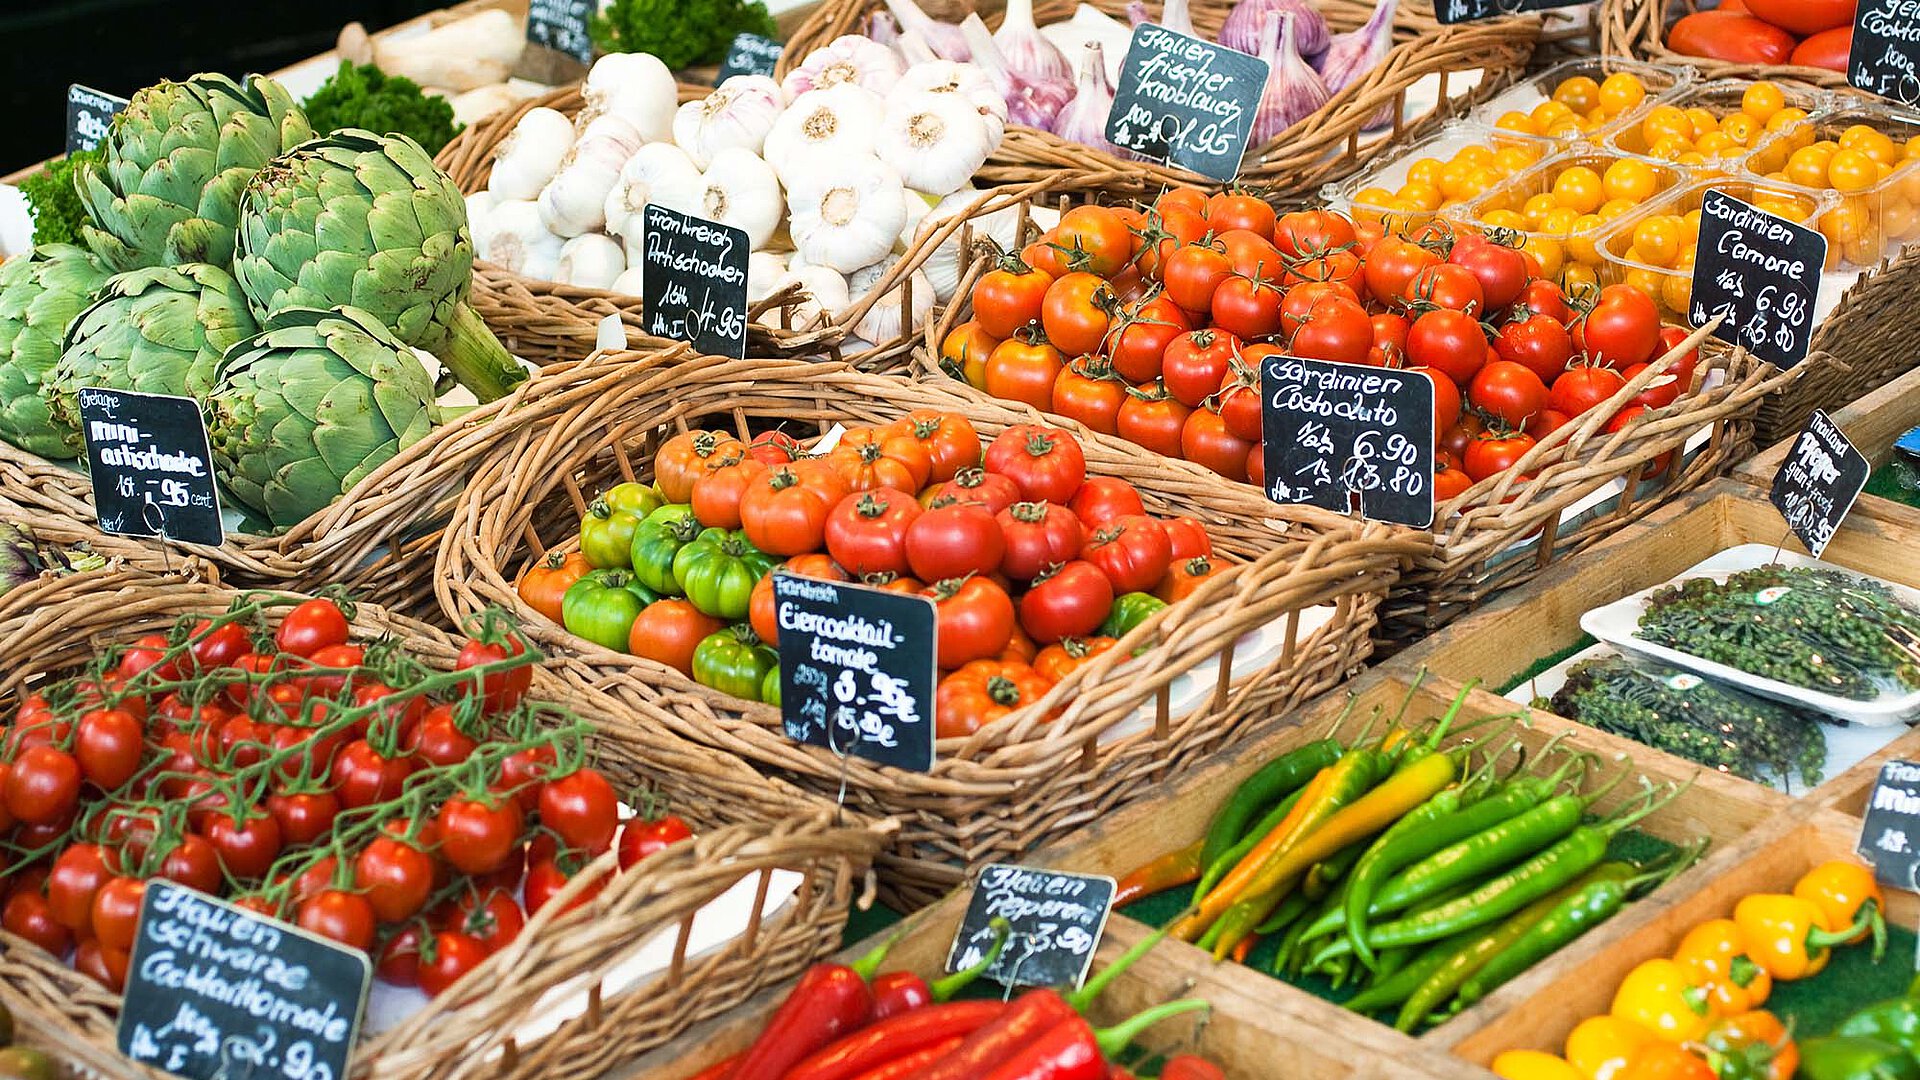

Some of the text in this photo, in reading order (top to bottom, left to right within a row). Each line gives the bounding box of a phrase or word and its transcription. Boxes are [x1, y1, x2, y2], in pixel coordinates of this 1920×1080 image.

[1138, 29, 1216, 64] Italien
[1137, 52, 1234, 92] frischer
[1717, 230, 1806, 280] Camone
[1353, 431, 1418, 466] 6.90
[1810, 411, 1850, 458] Thailand
[191, 492, 214, 508] cent
[811, 636, 879, 675] tomate
